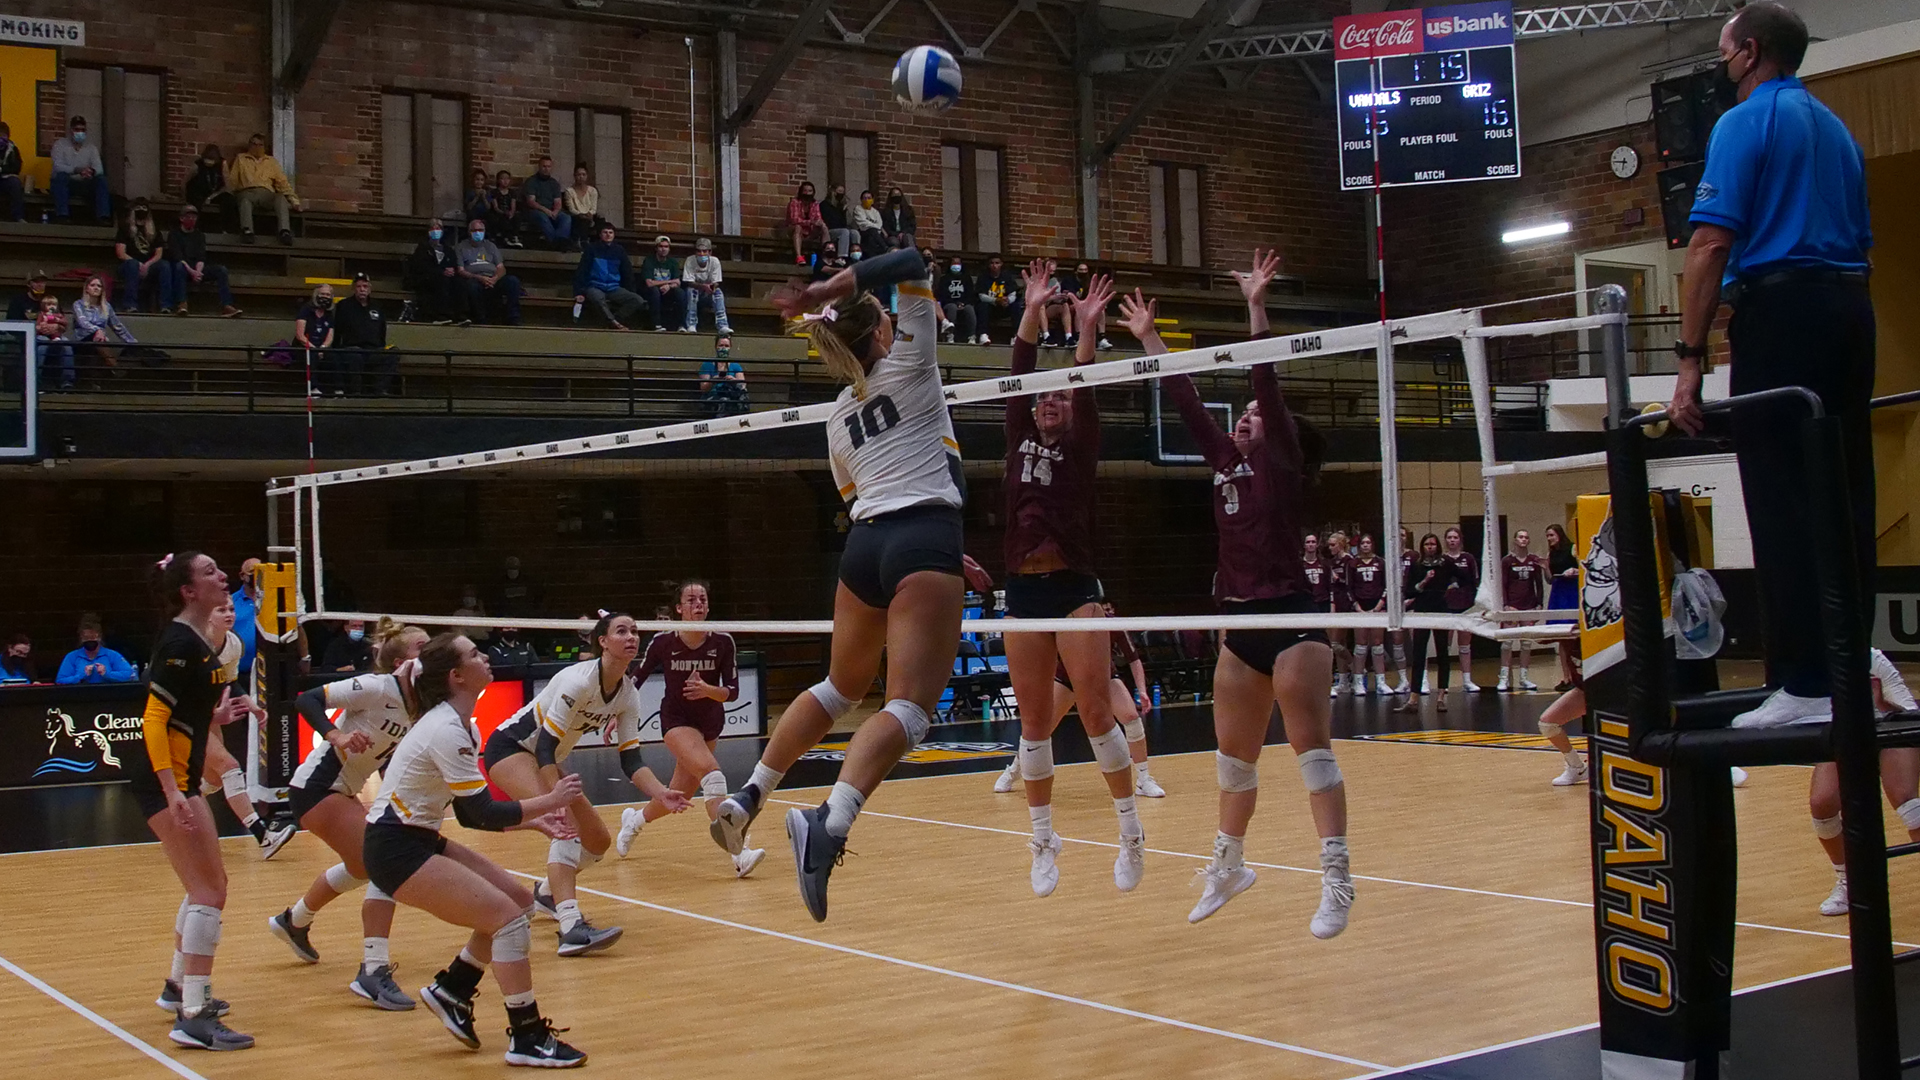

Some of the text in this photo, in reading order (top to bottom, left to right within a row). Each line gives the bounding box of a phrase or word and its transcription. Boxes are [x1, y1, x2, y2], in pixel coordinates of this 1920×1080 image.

[1, 20, 78, 40] MOKING
[1462, 83, 1492, 99] GRIZ
[1410, 95, 1442, 106] PERIOD
[1483, 99, 1509, 126] 16
[1400, 133, 1459, 147] PLAYER FOUL
[1484, 128, 1513, 140] FOULS
[1343, 139, 1372, 151] FOULS
[1414, 170, 1445, 181] MATCH
[1486, 164, 1516, 176] SCORE
[1345, 175, 1373, 186] SCORE
[1291, 336, 1322, 354] IDAHO
[1133, 359, 1160, 375] IDAHO
[998, 379, 1022, 393] IDAHO
[781, 410, 800, 422] IDAHO
[844, 394, 901, 450] 10
[1021, 455, 1052, 486] 14
[1691, 484, 1702, 497] G
[1222, 483, 1239, 515] 3
[671, 660, 716, 671] MONTANA
[280, 715, 289, 741] sports
[107, 732, 143, 742] CASIN
